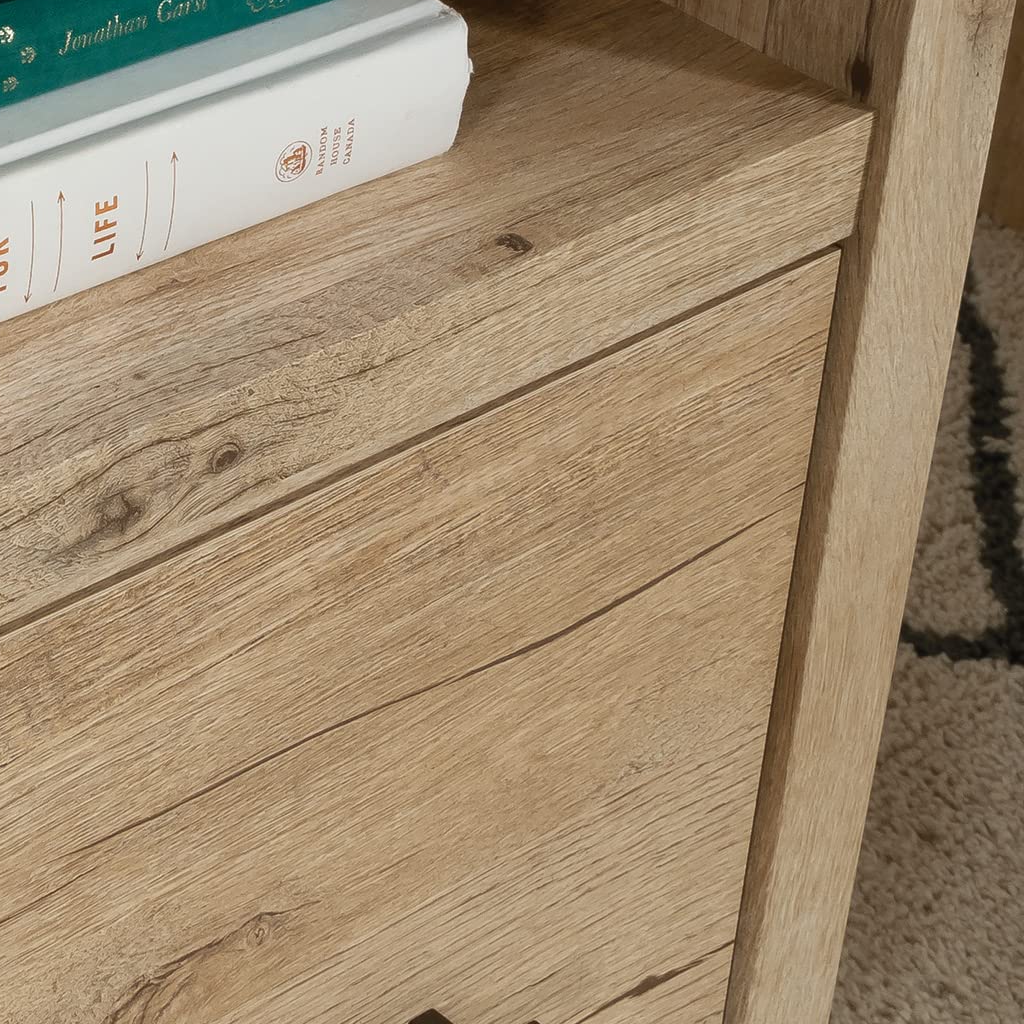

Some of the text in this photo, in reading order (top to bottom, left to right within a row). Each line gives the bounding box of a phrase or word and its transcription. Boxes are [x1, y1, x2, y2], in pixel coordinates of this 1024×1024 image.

[58, 14, 148, 56] Jonathan
[315, 126, 328, 176] RANDOM
[330, 127, 342, 166] HOUSE
[342, 118, 355, 165] CANADA
[91, 195, 119, 261] LIFE
